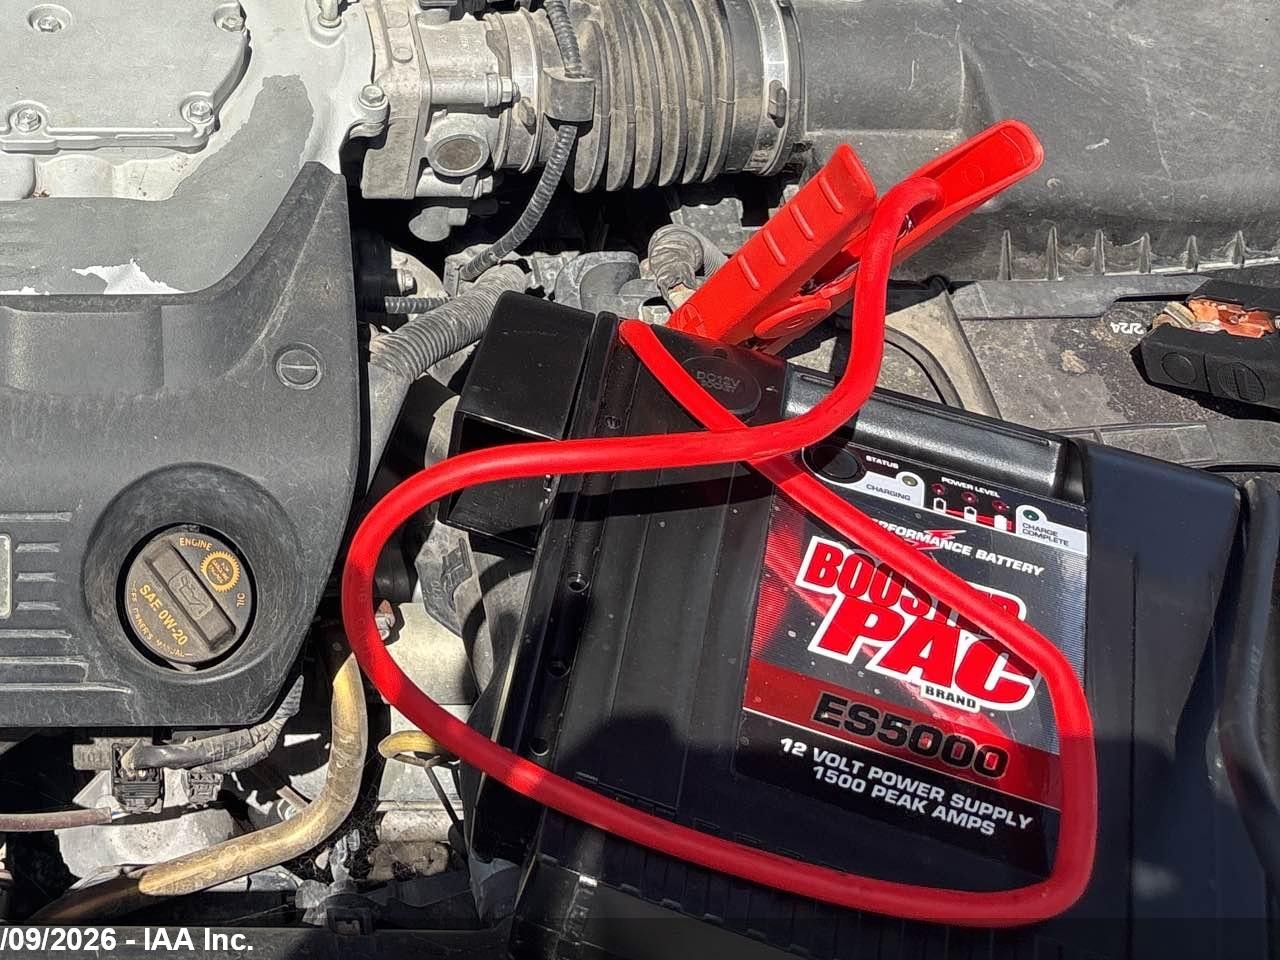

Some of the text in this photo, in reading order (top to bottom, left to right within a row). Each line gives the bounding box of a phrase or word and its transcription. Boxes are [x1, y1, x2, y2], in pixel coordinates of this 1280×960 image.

[1110, 321, 1145, 335] 2/24
[865, 455, 899, 469] STATUS
[866, 483, 911, 501] CHARGING
[941, 476, 1001, 498] POWER LEVEL
[1022, 522, 1059, 536] CHARGE
[1022, 529, 1070, 547] COMPLETE
[179, 537, 213, 551] ENGINE
[975, 548, 1045, 576] BATTERY
[236, 592, 246, 608] OIL
[139, 584, 188, 646] SAE 0W-20
[814, 594, 1033, 708] PAC
[924, 685, 978, 709] BRAND
[811, 692, 1009, 780] ES5000
[780, 737, 1033, 830] 12 VOLT POWER SUPPLY
[813, 765, 996, 836] 1500 PEAK AMPS
